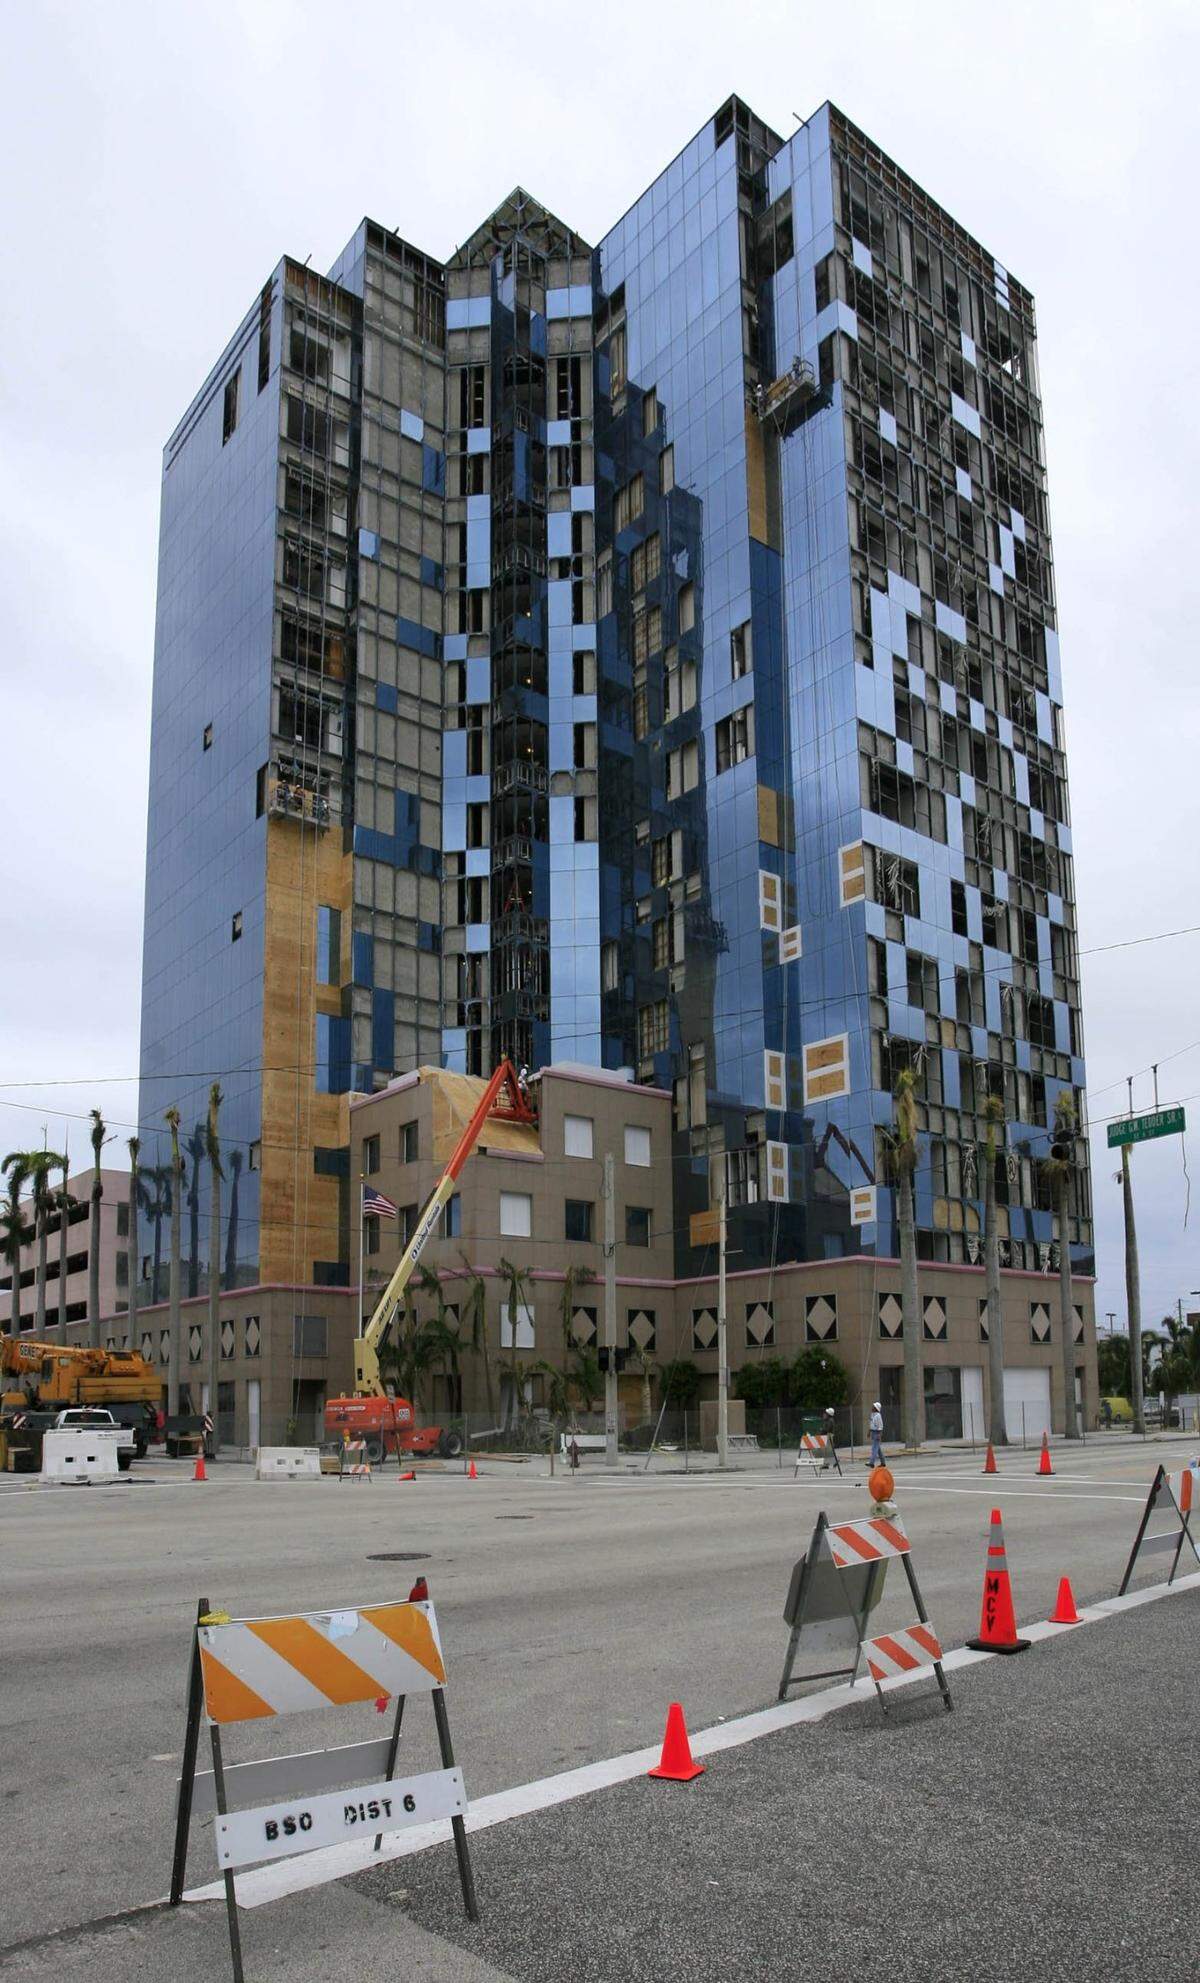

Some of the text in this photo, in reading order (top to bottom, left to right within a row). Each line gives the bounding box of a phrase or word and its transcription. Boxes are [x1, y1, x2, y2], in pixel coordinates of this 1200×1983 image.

[265, 1793, 416, 1841] BSO DIST 6
